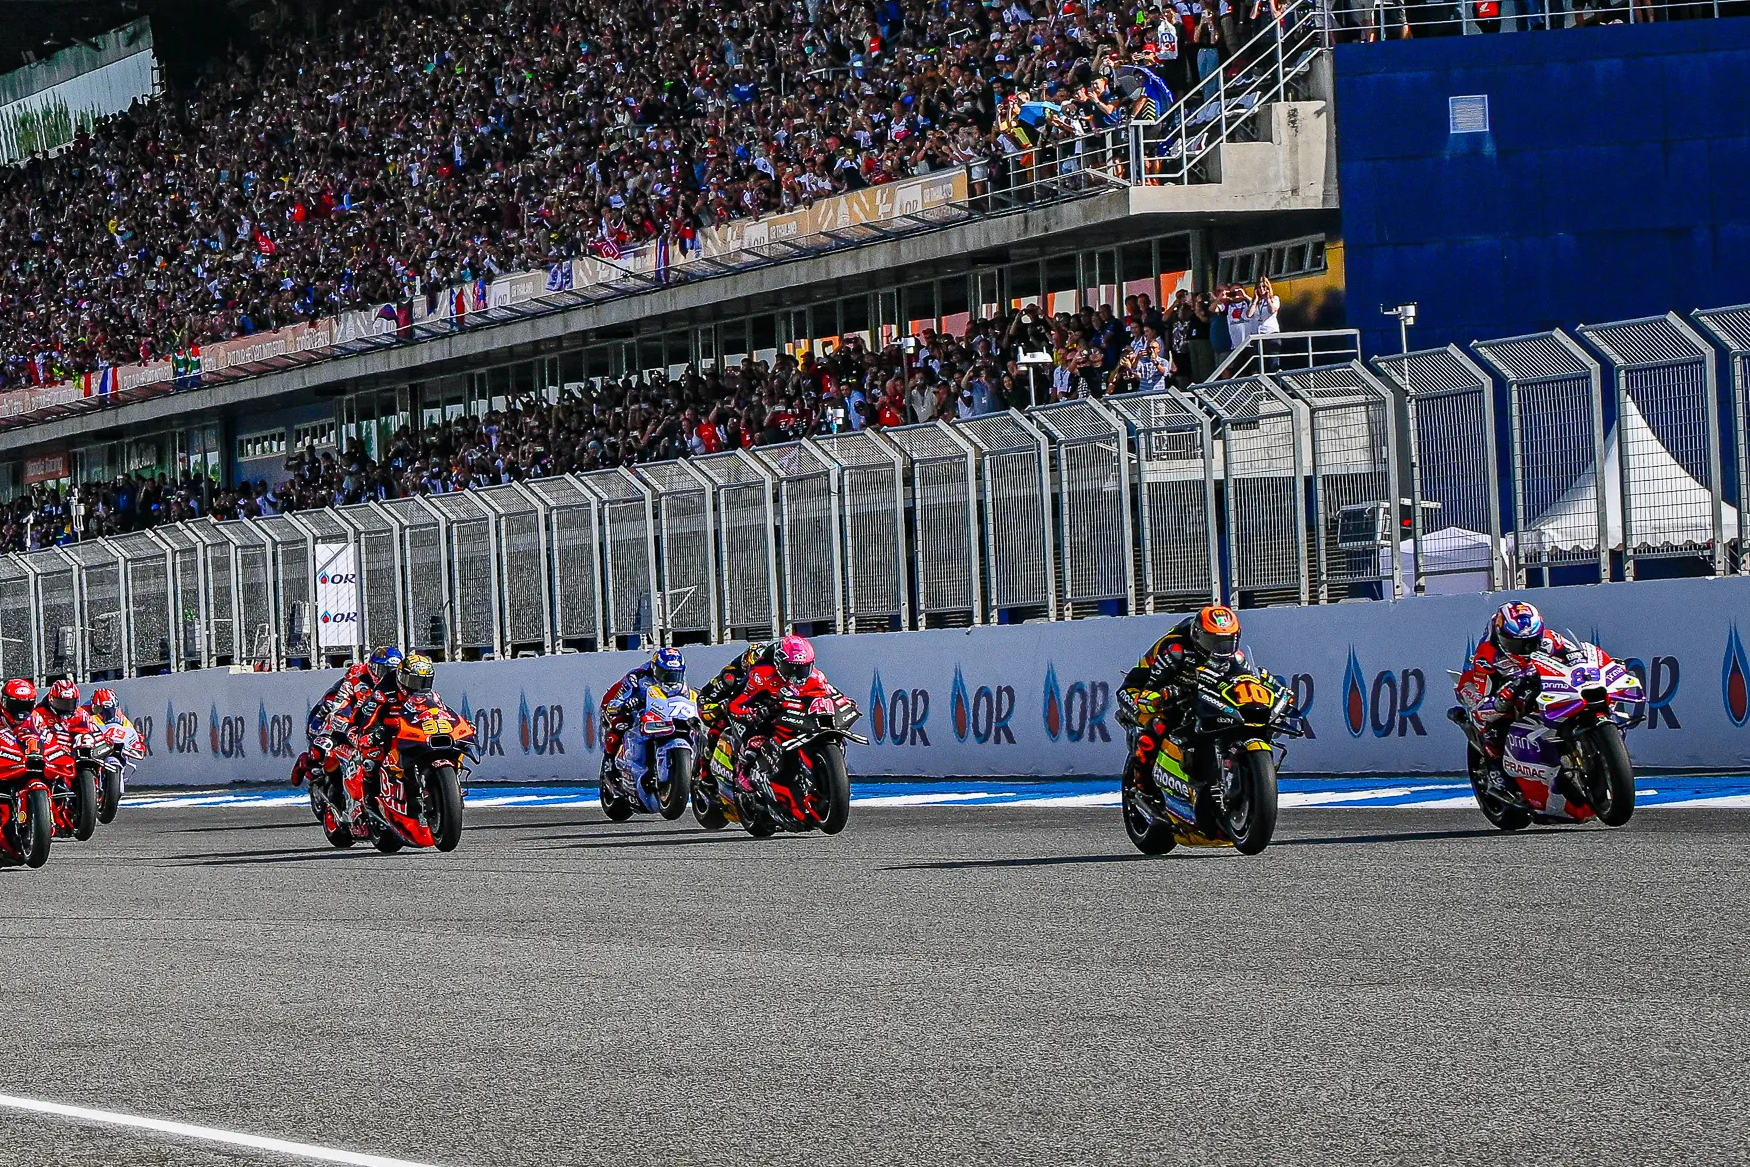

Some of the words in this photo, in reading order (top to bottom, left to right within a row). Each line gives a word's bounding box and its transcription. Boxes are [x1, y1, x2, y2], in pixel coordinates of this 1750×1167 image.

[331, 573, 356, 584] OR
[332, 611, 357, 623] OR
[1233, 683, 1270, 704] 10
[1542, 682, 1570, 690] prima
[808, 697, 836, 714] 41
[889, 688, 931, 747] OR
[972, 684, 1017, 745] OR
[1065, 680, 1112, 743] OR
[1370, 667, 1428, 737] OR
[176, 711, 199, 753] OR
[221, 715, 246, 758] OR
[270, 714, 296, 758] OR
[421, 719, 454, 734] 33
[474, 707, 506, 757] OR
[533, 704, 565, 755] OR
[0, 750, 22, 762] Lenovo
[25, 738, 41, 754] 1
[1505, 760, 1548, 781] PRAMAC
